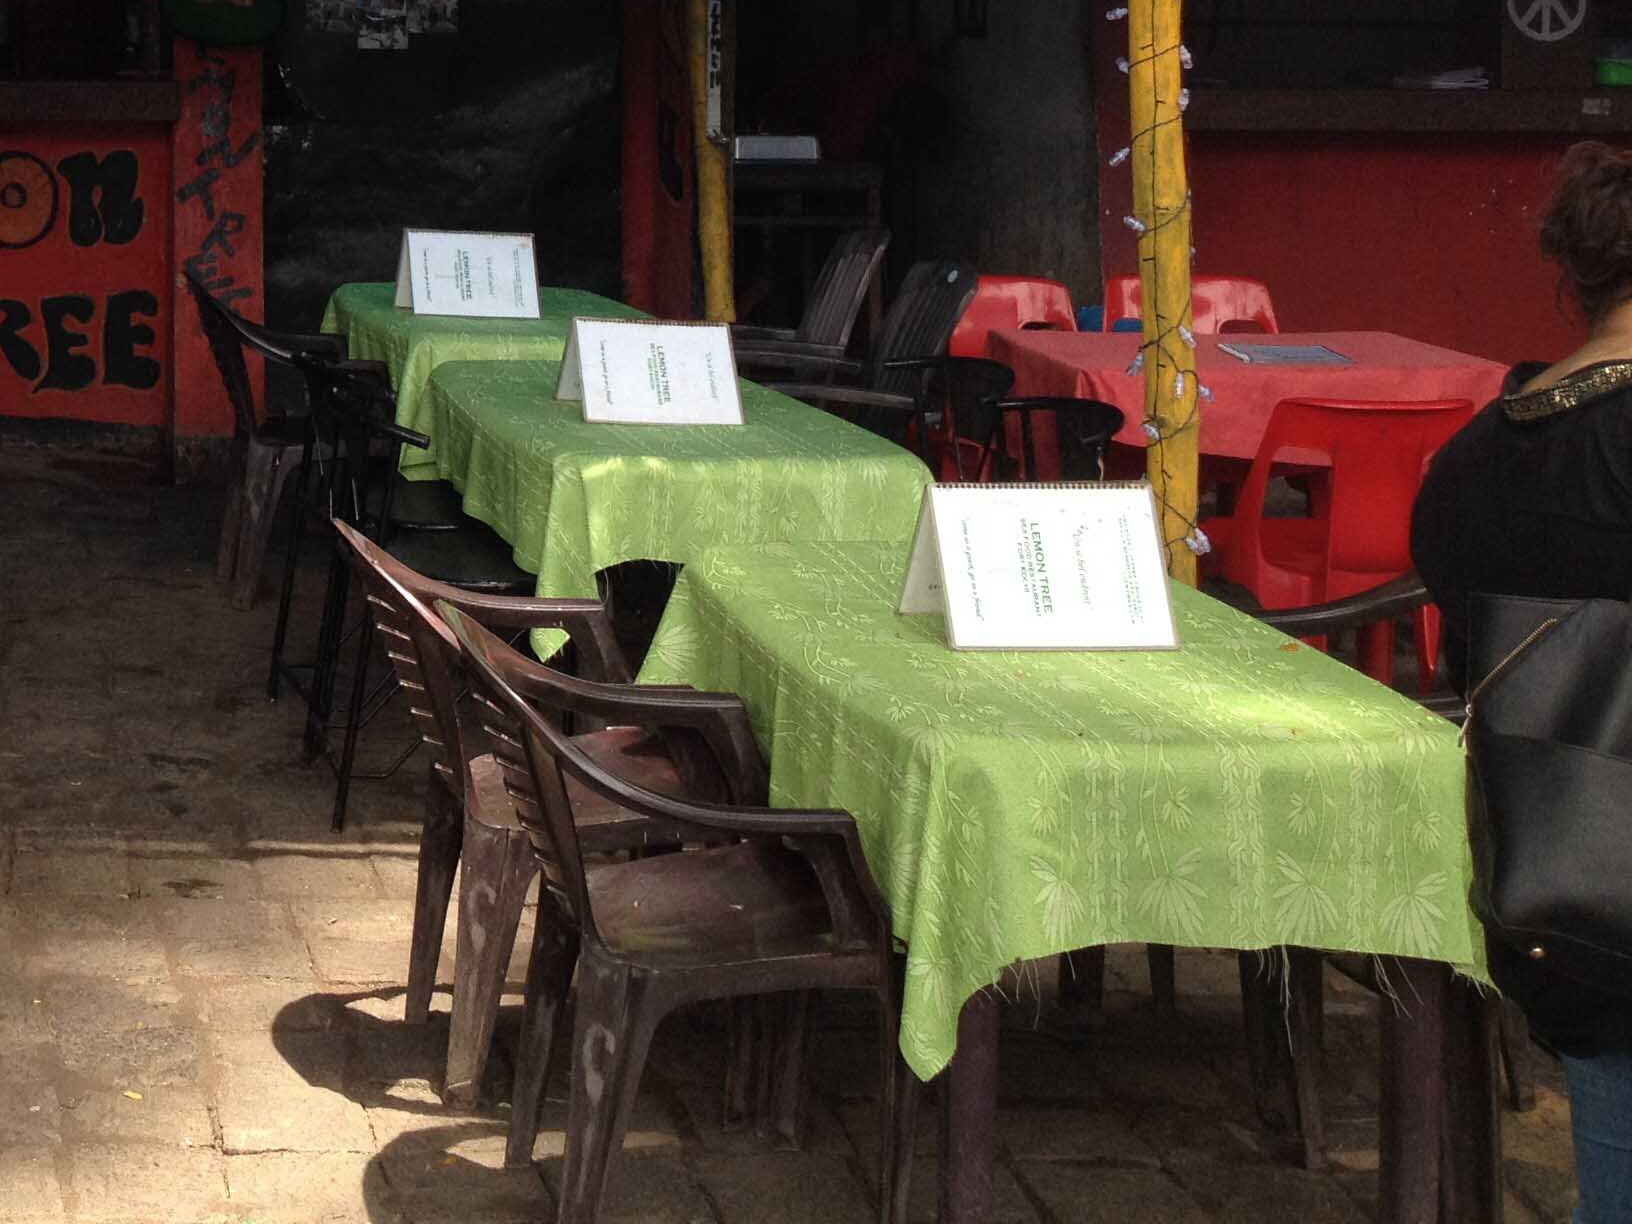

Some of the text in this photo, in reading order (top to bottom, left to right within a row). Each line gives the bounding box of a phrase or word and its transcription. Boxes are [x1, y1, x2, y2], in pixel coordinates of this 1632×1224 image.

[656, 345, 668, 378] LEMON
[1030, 521, 1054, 615] LEMON TREE
